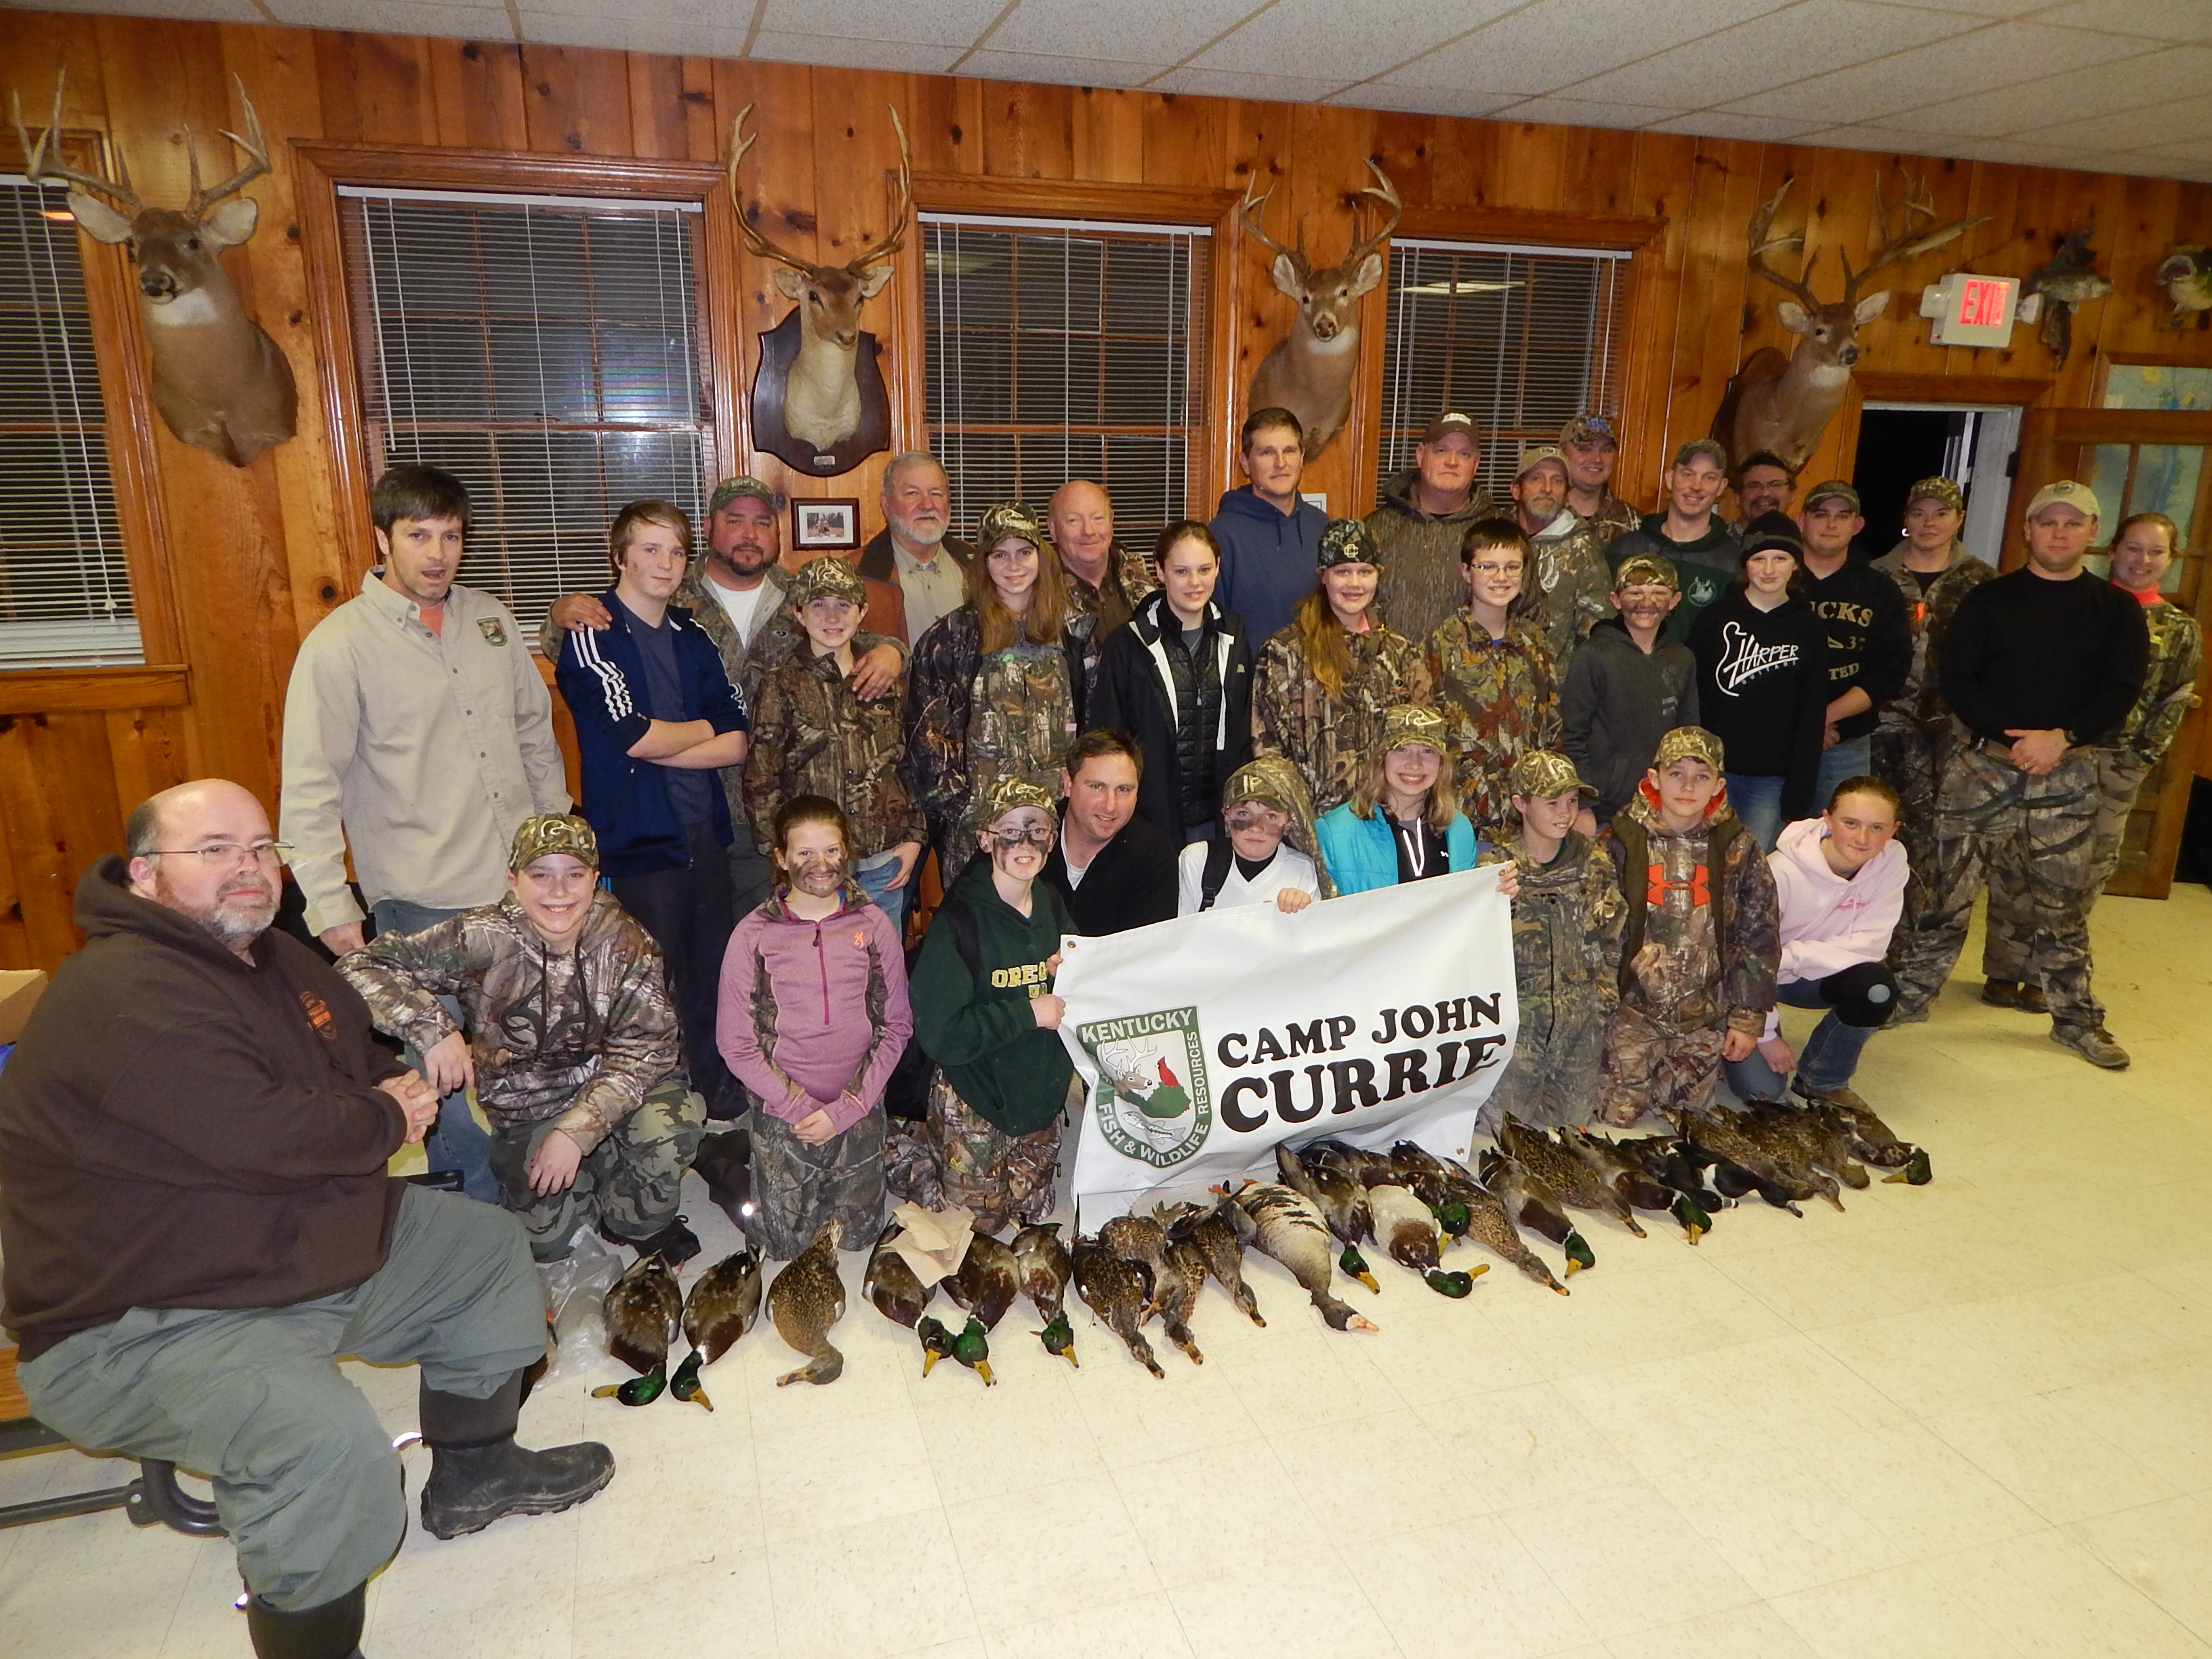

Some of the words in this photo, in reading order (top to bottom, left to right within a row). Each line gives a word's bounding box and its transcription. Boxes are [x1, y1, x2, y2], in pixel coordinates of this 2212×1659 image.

[1959, 279, 2011, 327] EXIT
[1723, 634, 1799, 689] HARPER
[1082, 1008, 1193, 1043] KENTUCKY
[1218, 1015, 1356, 1068] CAMP
[1372, 992, 1501, 1044] JOHN
[1099, 1103, 1126, 1145] FISH
[1124, 1141, 1136, 1155] &
[1141, 1122, 1209, 1166] WILDLIFE
[1187, 1031, 1210, 1115] RESOURCES
[1221, 1033, 1506, 1132] CURRIE
